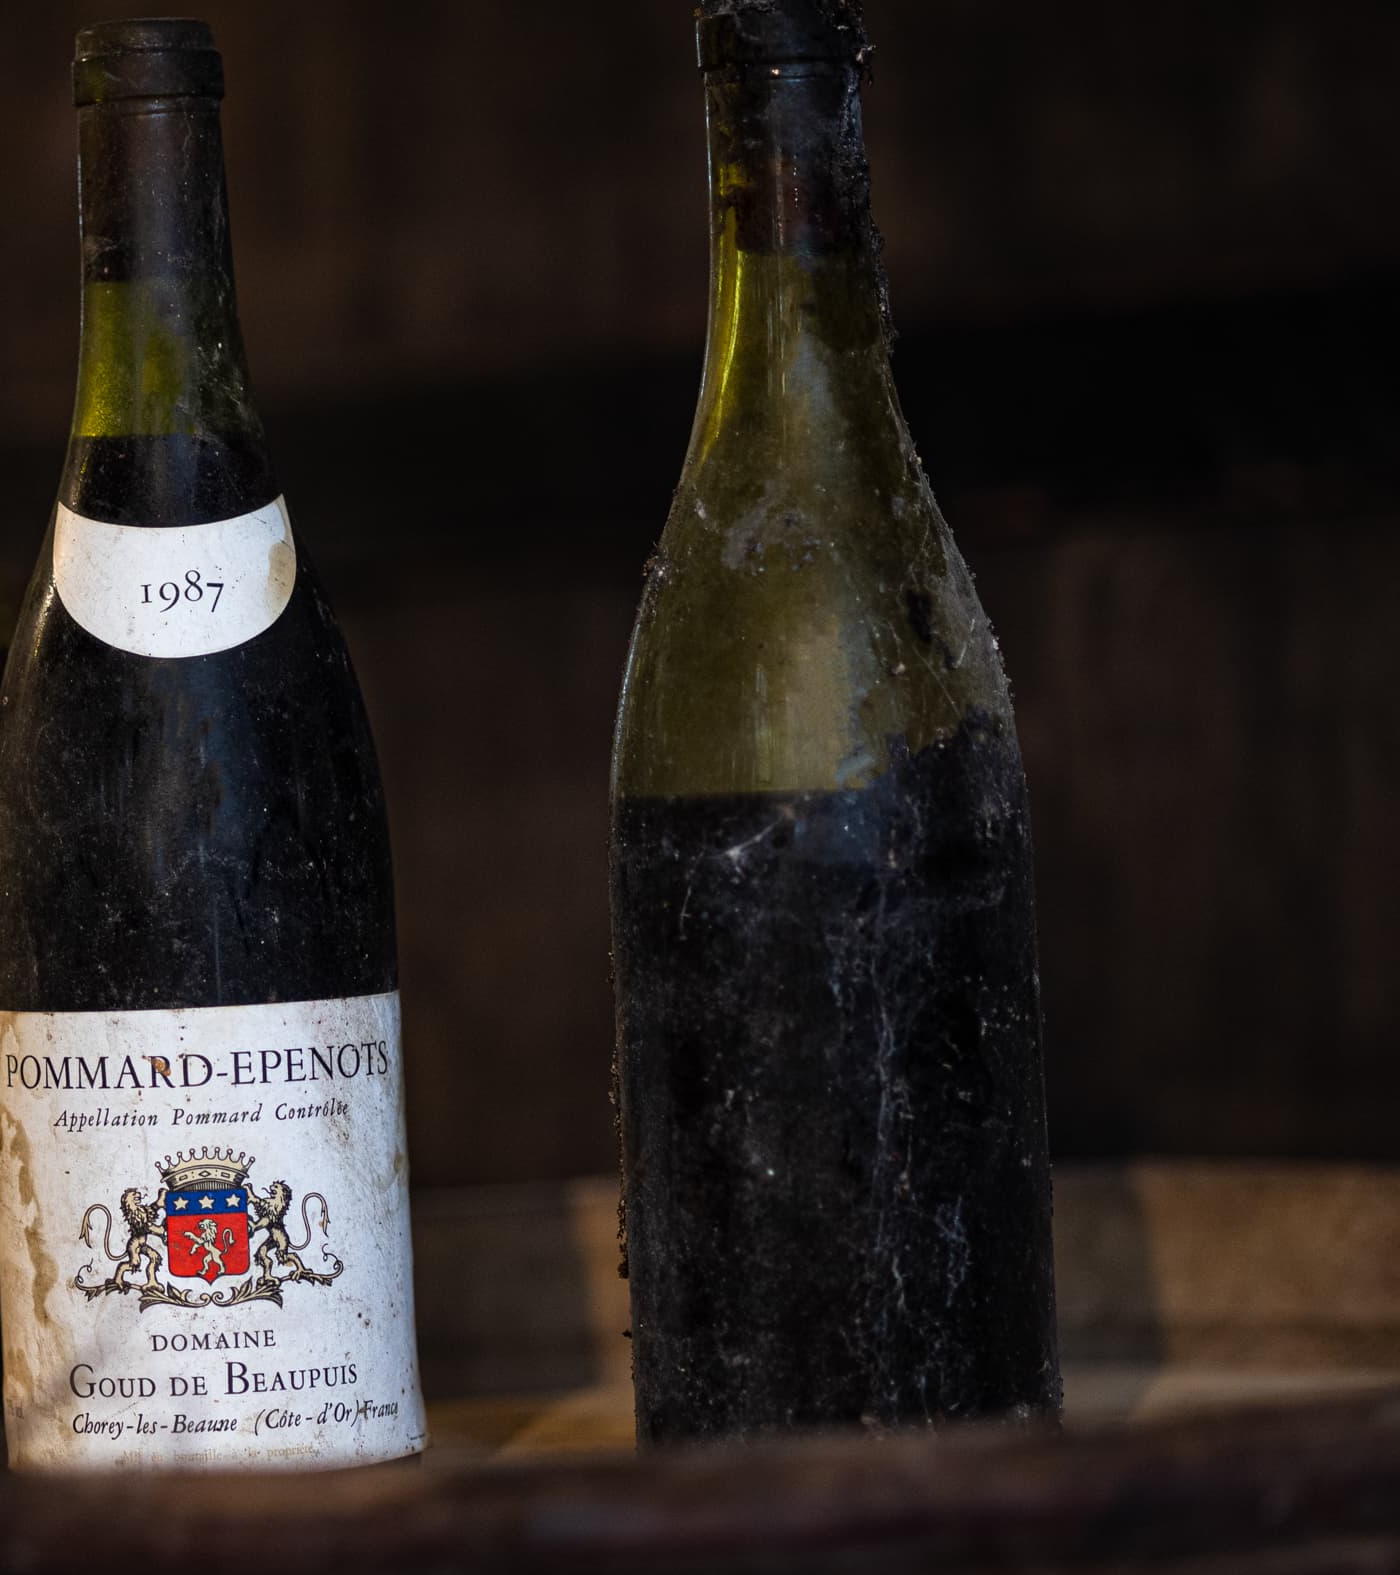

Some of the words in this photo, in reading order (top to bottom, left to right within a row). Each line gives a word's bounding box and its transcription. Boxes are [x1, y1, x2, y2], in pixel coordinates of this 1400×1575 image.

[140, 569, 224, 613] 1987
[6, 1041, 388, 1089] POMMARD-EPENOTS
[54, 1108, 159, 1132] Appellation
[171, 1103, 263, 1125] Pommard
[151, 1329, 276, 1352] DOMAINE
